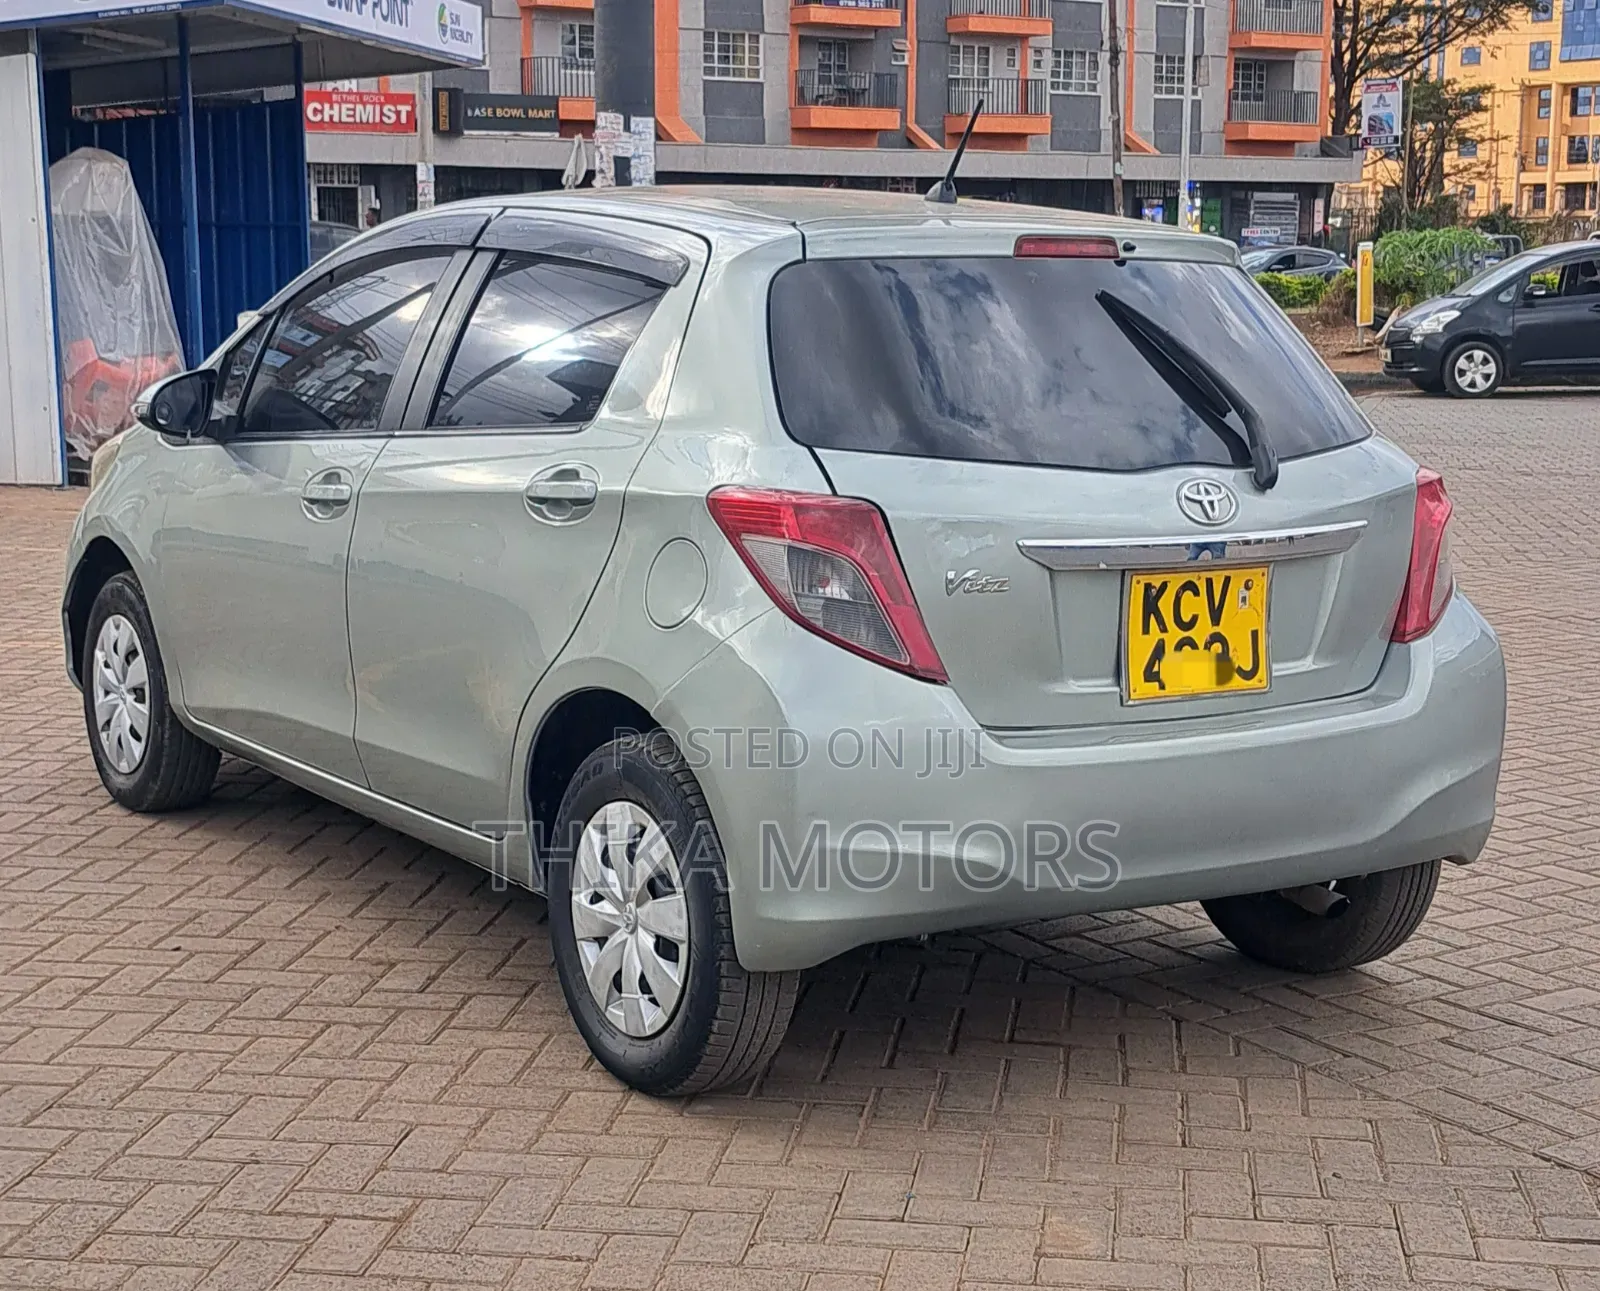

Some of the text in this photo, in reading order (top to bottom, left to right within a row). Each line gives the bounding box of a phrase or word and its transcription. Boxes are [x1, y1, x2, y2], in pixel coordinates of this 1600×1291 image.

[372, 0, 409, 28] POINT
[306, 102, 412, 124] CHEMIST
[496, 108, 526, 118] BOWL
[528, 108, 556, 119] MART
[1141, 575, 1232, 635] KCV
